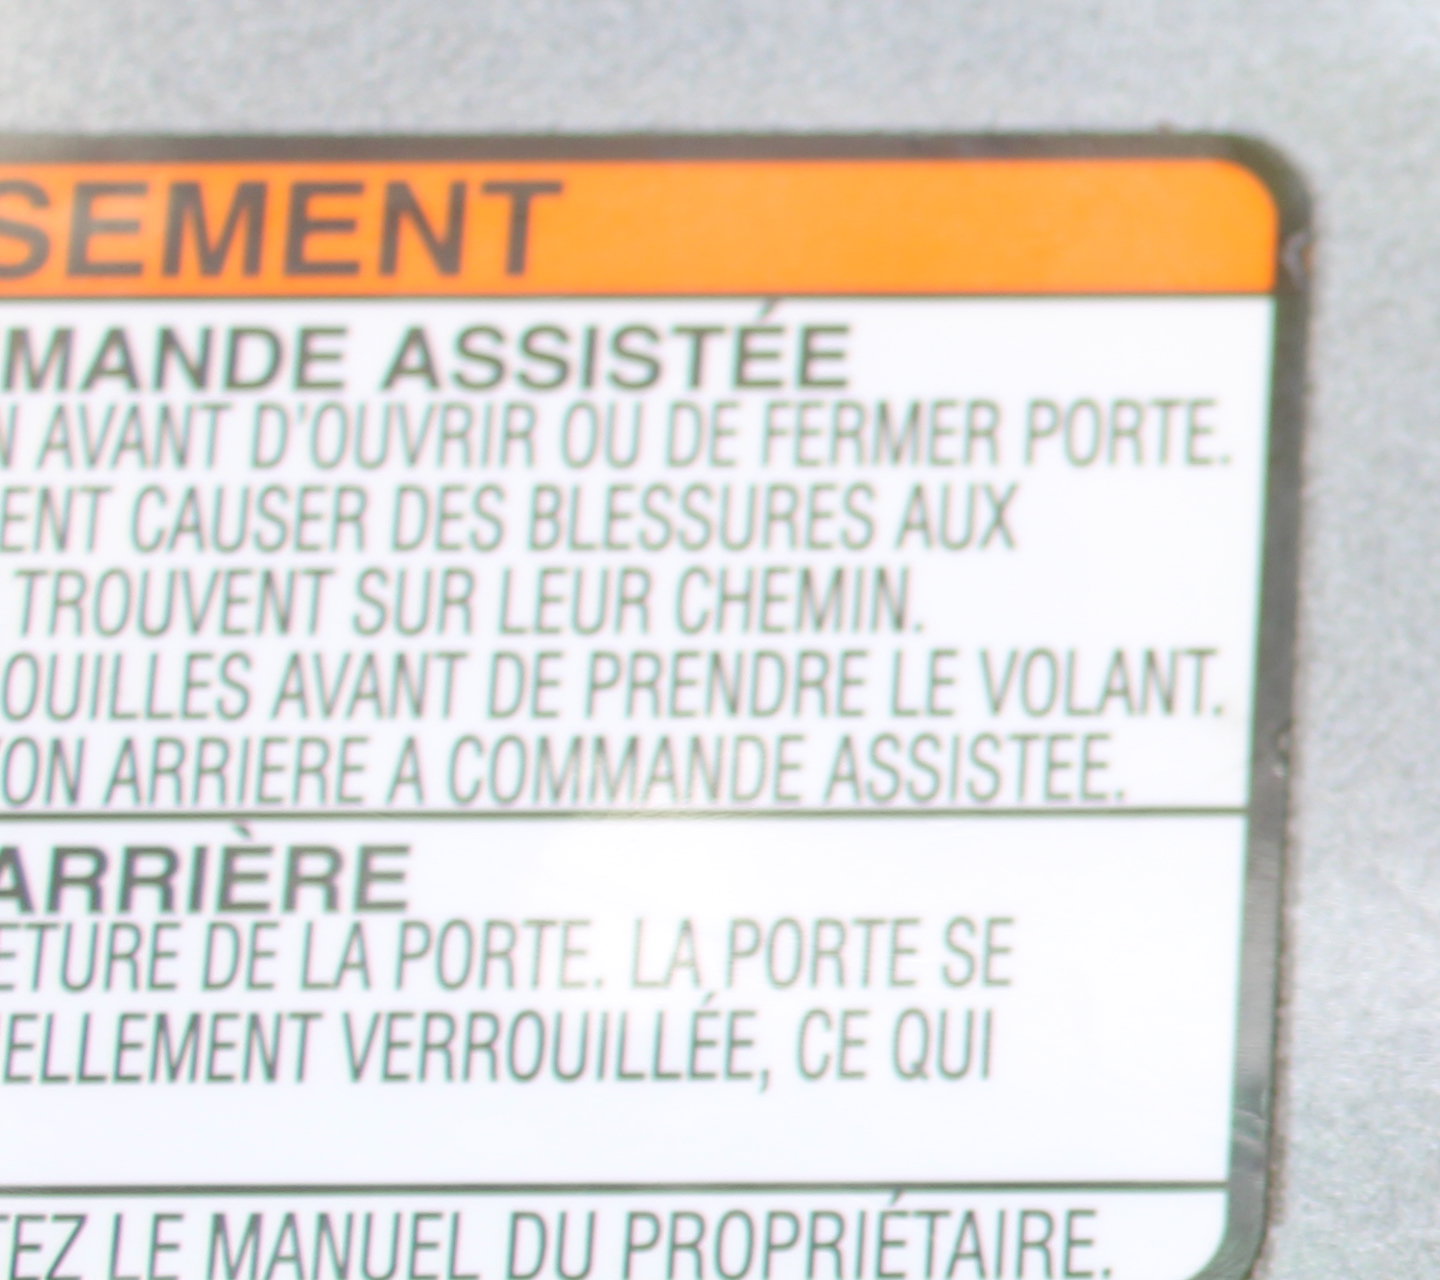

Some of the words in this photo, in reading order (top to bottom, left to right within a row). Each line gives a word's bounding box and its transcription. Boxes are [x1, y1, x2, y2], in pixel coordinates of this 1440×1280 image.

[0, 179, 564, 279] SEMENT
[0, 324, 349, 394] MANDE
[377, 300, 852, 393] ASSISTÉE
[34, 400, 234, 471] AVANT
[247, 399, 539, 472] D'OUVRIR
[558, 399, 645, 471] OU
[663, 399, 742, 470] DE
[759, 397, 1003, 468] FERMER
[1022, 397, 1232, 469] PORTE.
[0, 484, 114, 555] ENT
[128, 482, 370, 556] CAUSER
[389, 481, 507, 555] DES
[525, 481, 877, 553] BLESSURES
[893, 481, 1020, 553] AUX
[12, 566, 337, 640] TROUVENT
[350, 565, 477, 639] SUR
[496, 564, 654, 638] LEUR
[673, 564, 925, 637] CHEMIN.
[0, 649, 253, 724] OUILLES
[268, 649, 470, 721] AVANT
[484, 649, 565, 721] DE
[583, 647, 870, 720] PRENDRE
[888, 647, 960, 719] LE
[977, 647, 1226, 720] VOLANT.
[100, 734, 370, 811] ARRIERE
[383, 734, 426, 809] A
[445, 732, 806, 807] COMMANDE
[821, 731, 1133, 807] ASSISTEE.
[0, 821, 412, 916] ARRIÈRE
[199, 919, 280, 993] DE
[298, 919, 373, 993] LA
[391, 916, 603, 993] PORTE.
[628, 916, 704, 991] LA
[724, 916, 922, 991] PORTE
[939, 916, 1016, 990] SE
[339, 991, 771, 1094] VERROUILLÉE,
[794, 1006, 871, 1084] CE
[890, 1006, 994, 1083] QUI
